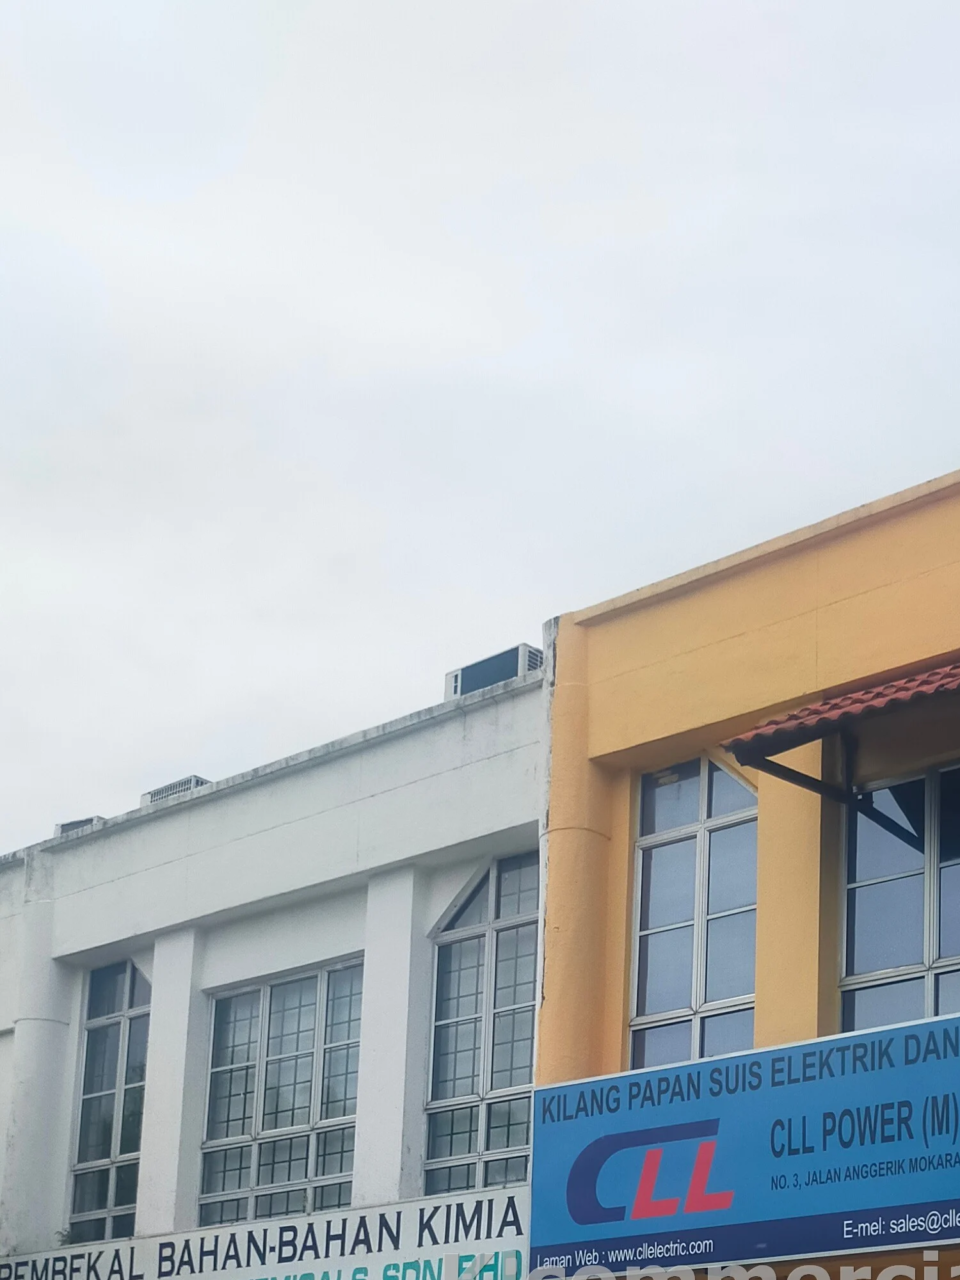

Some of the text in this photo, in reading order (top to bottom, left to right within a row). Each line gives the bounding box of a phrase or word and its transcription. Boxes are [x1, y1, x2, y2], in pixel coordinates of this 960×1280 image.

[542, 1085, 620, 1124] KILANG
[628, 1071, 700, 1110] PAPAN
[709, 1061, 762, 1097] SUIS
[771, 1037, 895, 1087] ELEKTRIK
[904, 1026, 960, 1066] DAN
[771, 1116, 815, 1159] CLL
[822, 1100, 914, 1152] POWER
[922, 1092, 960, 1149] (M)
[566, 1118, 735, 1226] CLL
[771, 1174, 790, 1190] NO.
[792, 1172, 802, 1190] 3,
[804, 1167, 841, 1187] JALAN
[843, 1158, 906, 1182] ANGGERIK
[157, 1210, 402, 1279] BAHAN-BAHAN
[417, 1195, 524, 1248] KIMIA
[536, 1254, 573, 1270] Laman
[575, 1249, 600, 1267] Web
[607, 1239, 714, 1264] www.cllelectric.com
[843, 1217, 886, 1239] E-mel:
